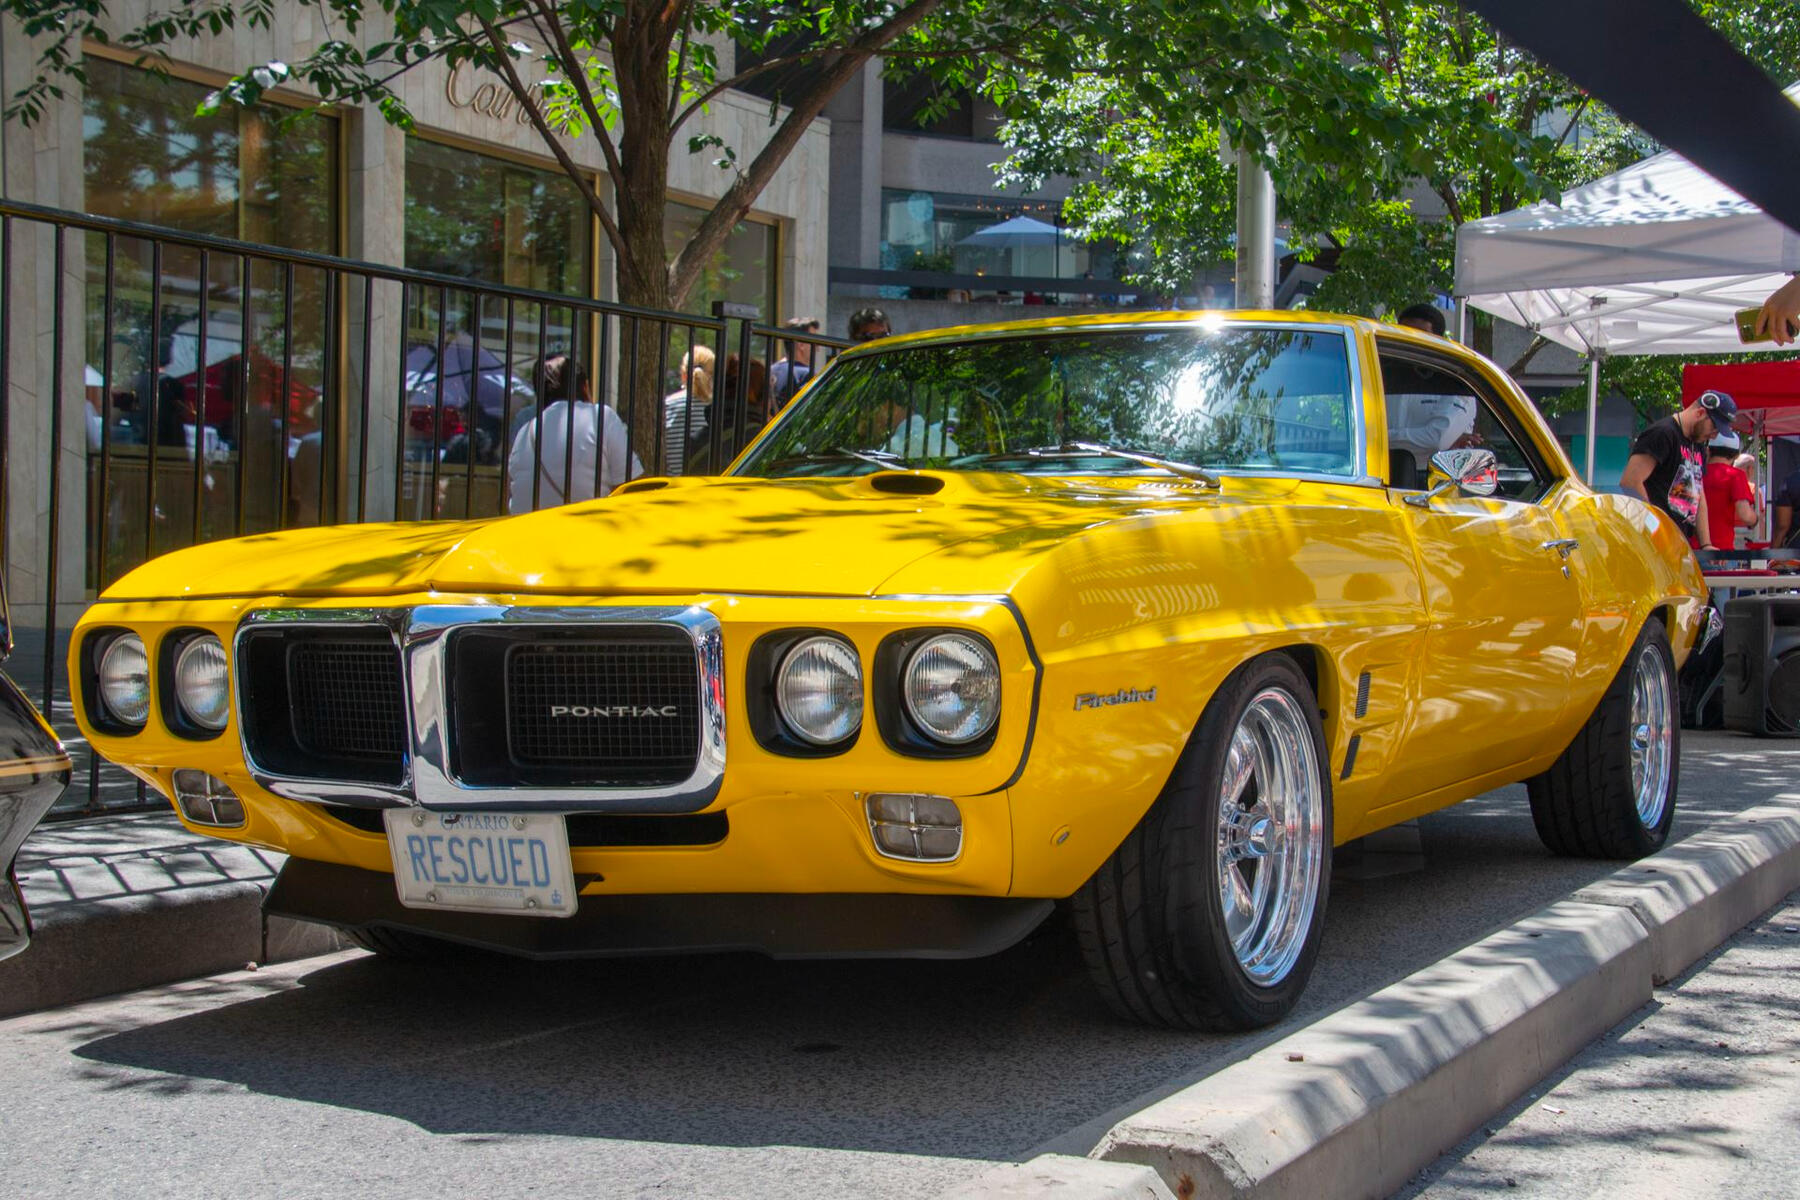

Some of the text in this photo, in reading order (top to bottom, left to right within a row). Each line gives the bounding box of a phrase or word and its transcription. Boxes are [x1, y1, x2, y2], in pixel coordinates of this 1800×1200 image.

[551, 705, 677, 717] PONTIAC
[1073, 686, 1157, 711] Firebird
[407, 835, 550, 888] RESCUED
